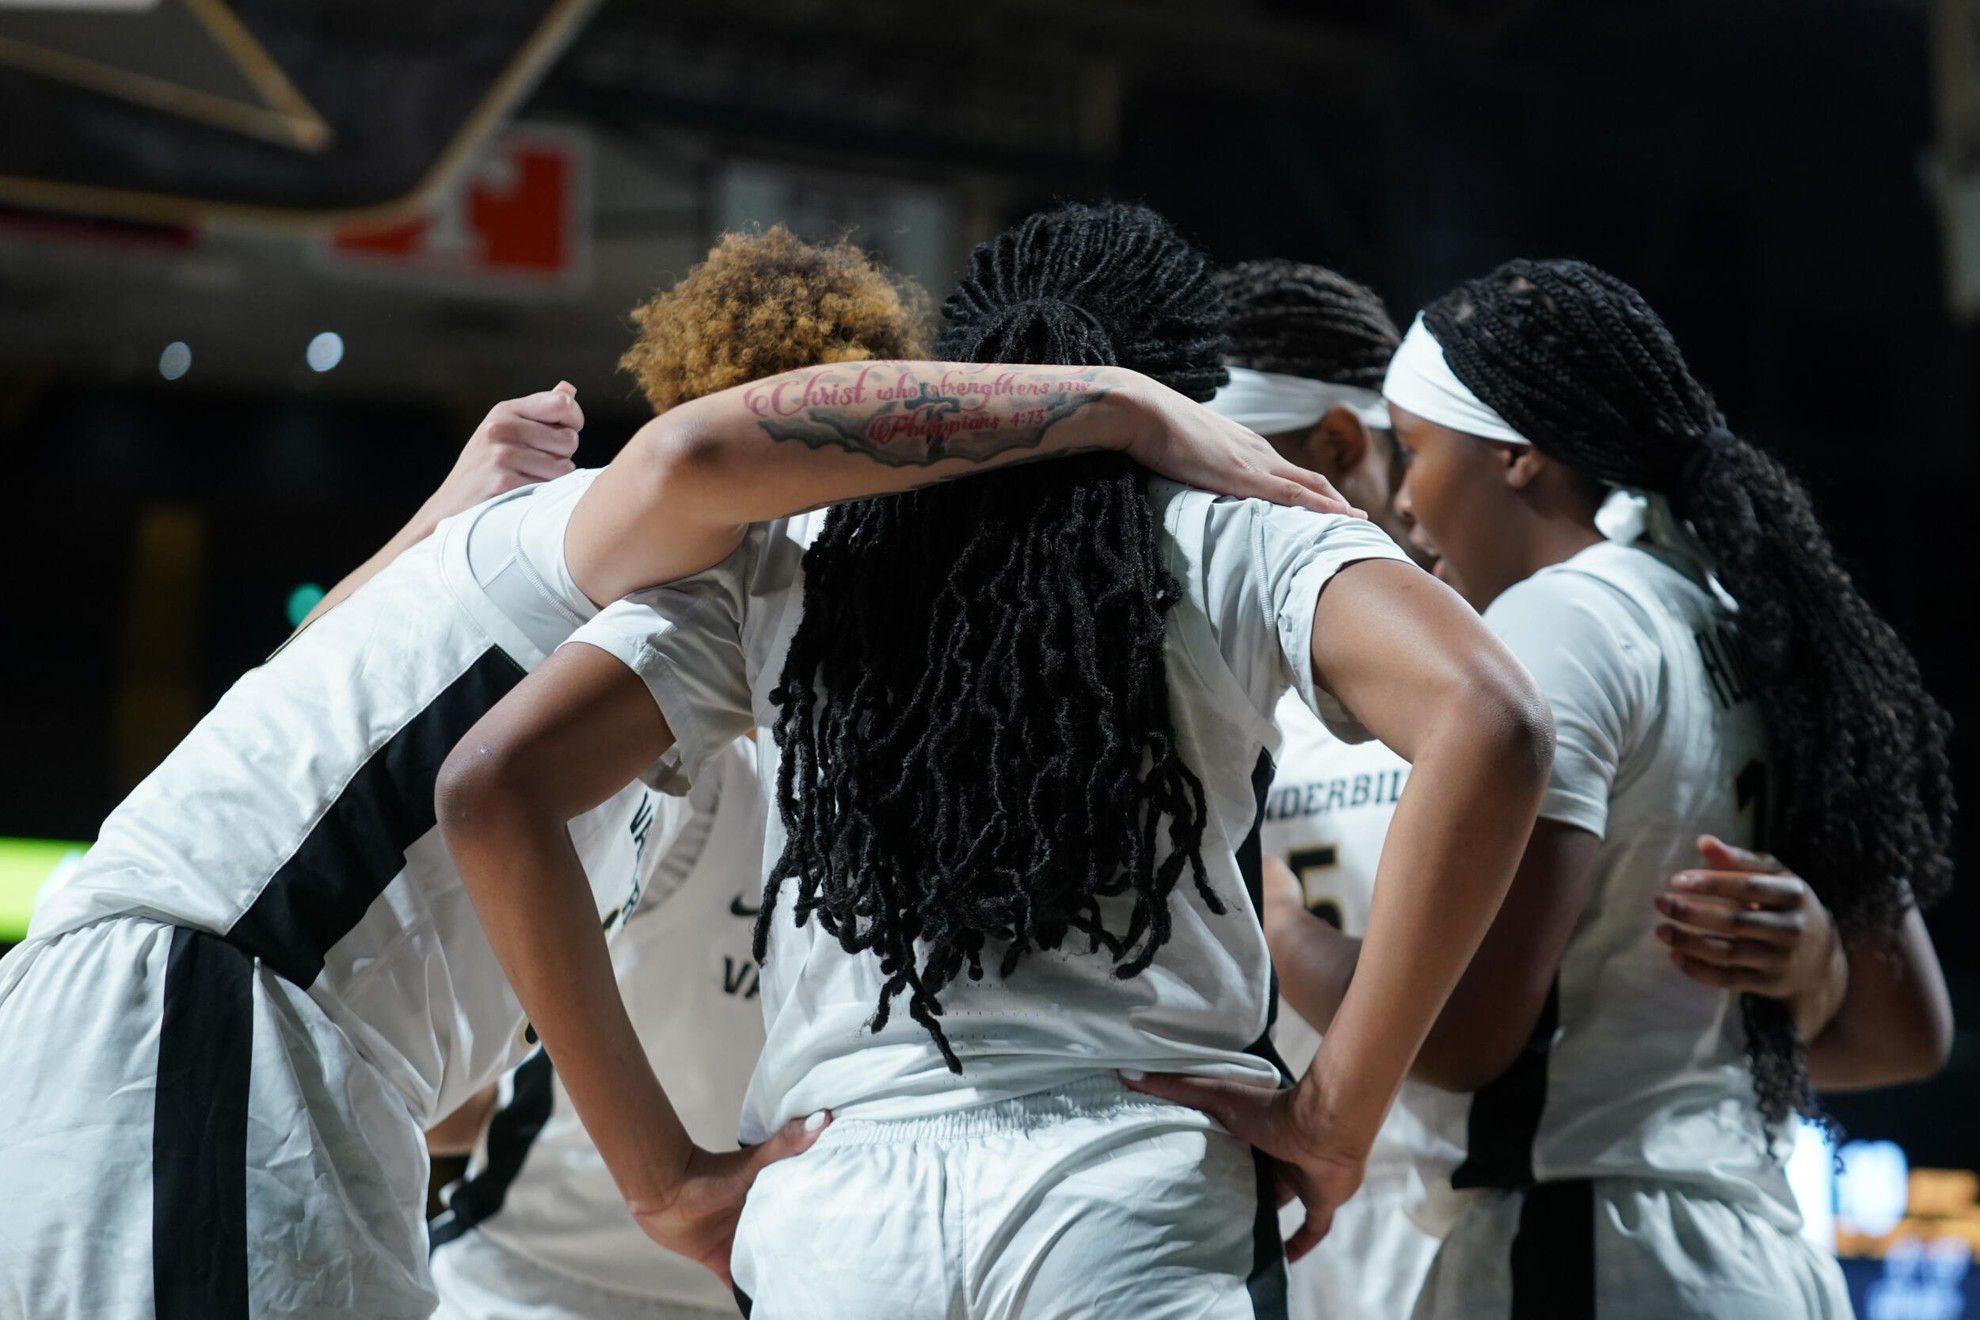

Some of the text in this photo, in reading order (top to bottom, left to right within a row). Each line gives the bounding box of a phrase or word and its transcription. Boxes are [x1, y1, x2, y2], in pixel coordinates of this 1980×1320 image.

[743, 365, 890, 417] Christ
[876, 371, 918, 401] who
[868, 401, 1045, 446] Philippians 4:13
